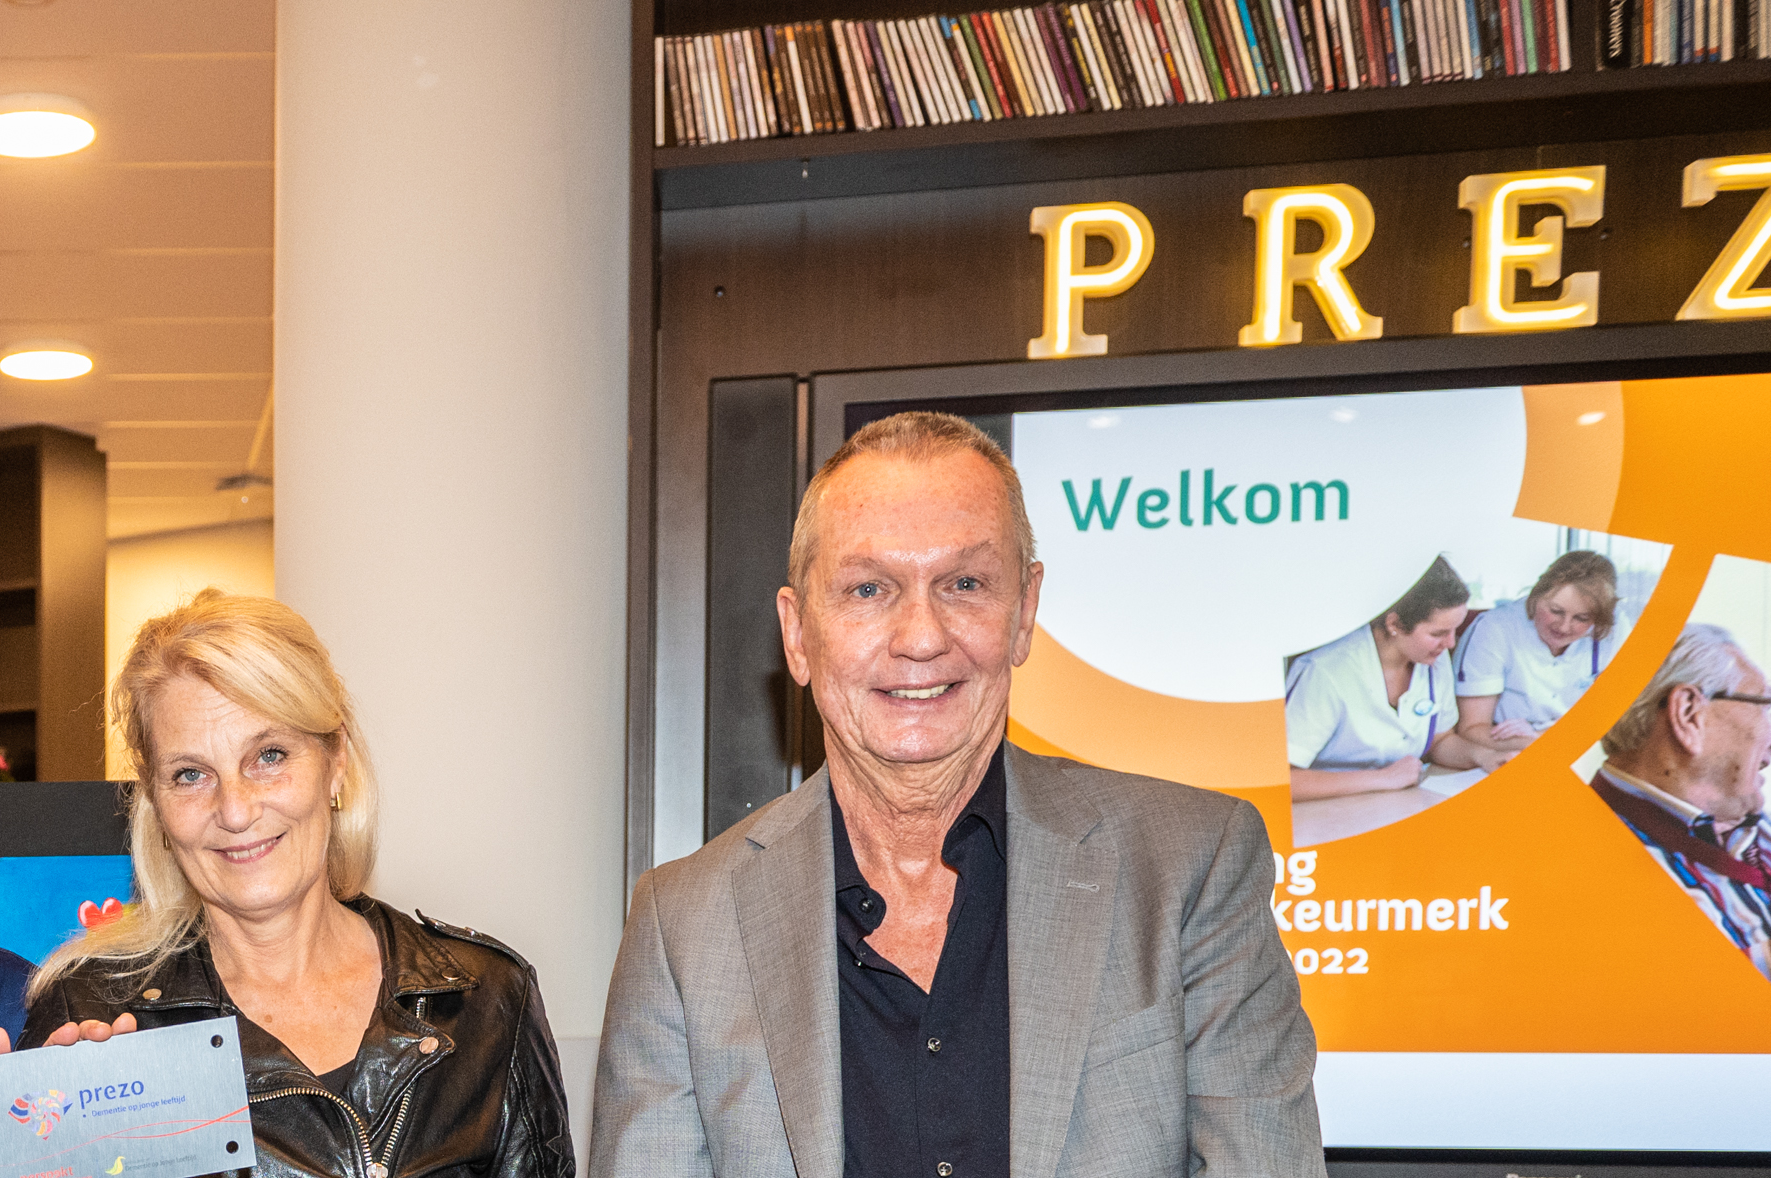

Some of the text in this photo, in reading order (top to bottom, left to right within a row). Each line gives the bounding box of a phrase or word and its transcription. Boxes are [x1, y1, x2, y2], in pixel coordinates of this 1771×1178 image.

[1028, 153, 1771, 360] PREZ
[1061, 468, 1351, 533] Welkom
[1270, 886, 1510, 932] keurmerk
[1286, 947, 1369, 975] 022
[79, 1080, 145, 1110] prezo
[91, 1094, 187, 1118] Dementie op jonge leeftijd
